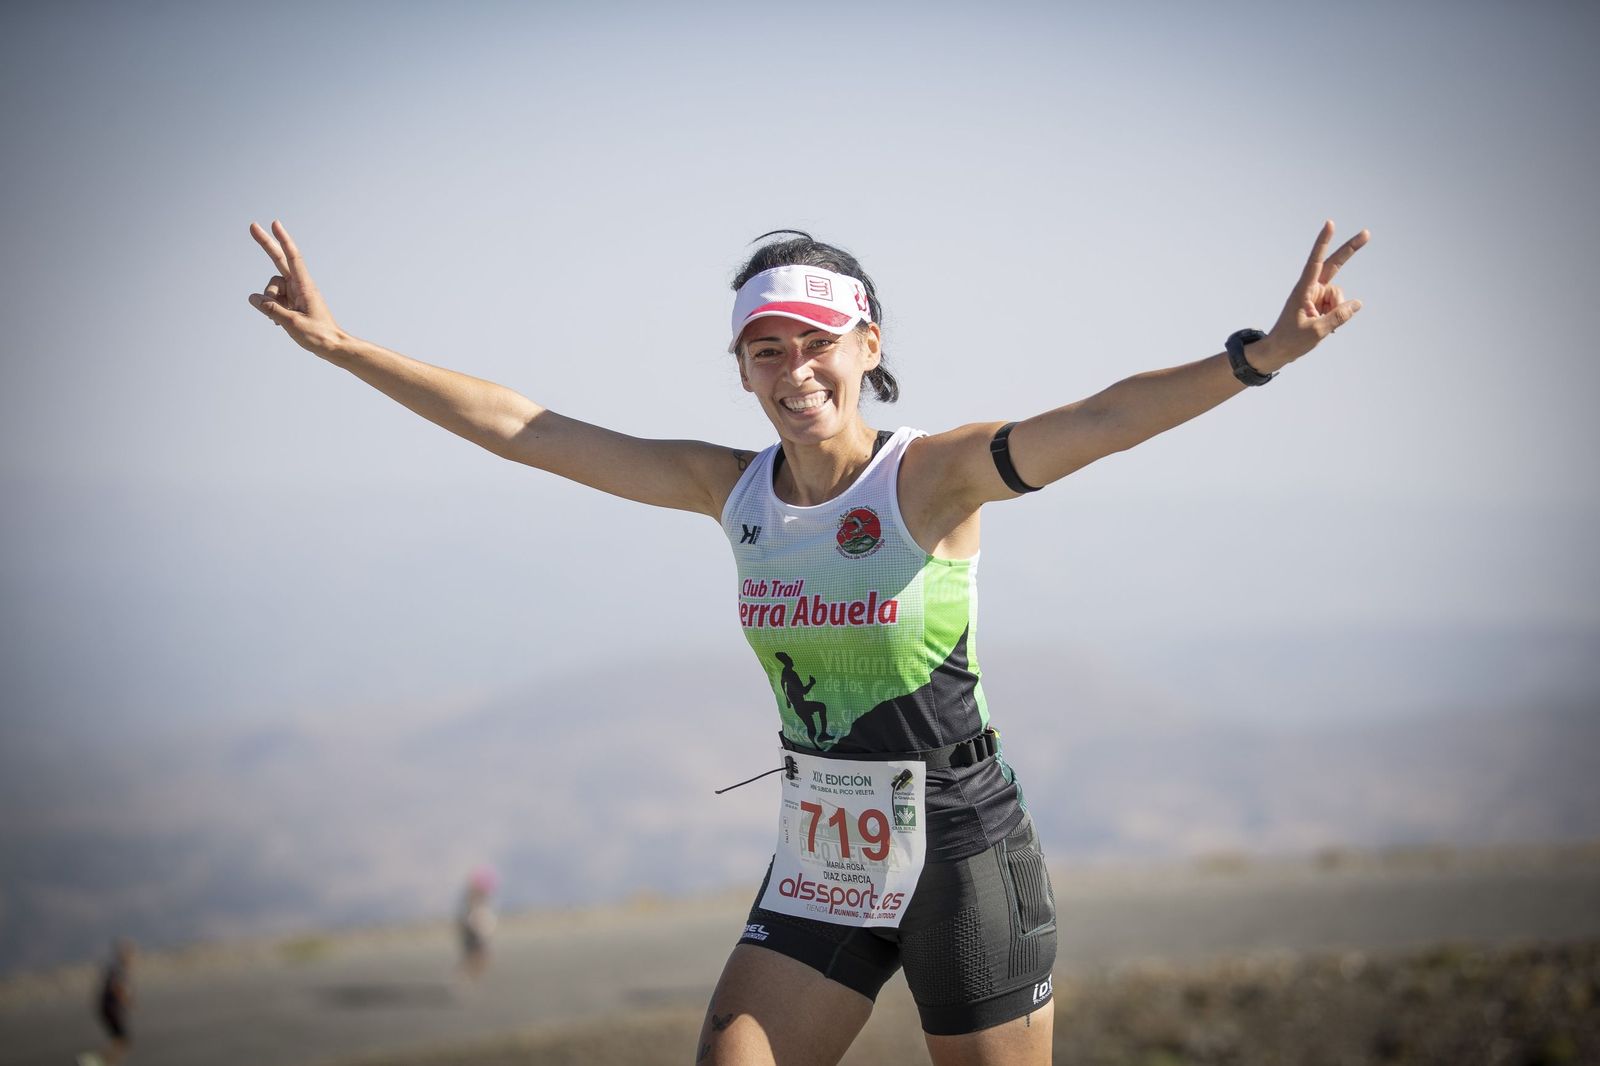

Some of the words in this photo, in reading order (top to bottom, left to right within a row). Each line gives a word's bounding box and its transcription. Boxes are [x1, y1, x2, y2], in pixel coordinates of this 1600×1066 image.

[743, 579, 767, 597] Club
[771, 580, 804, 597] Trail
[739, 602, 785, 627] erra
[791, 592, 898, 626] Abuela
[813, 771, 823, 783] XIX
[825, 773, 872, 786] EDICIÓN
[801, 800, 890, 861] 719
[826, 860, 845, 870] MARIA
[847, 863, 866, 871] ROSA
[823, 871, 840, 882] DIAZ
[841, 874, 872, 884] GARCIA
[806, 904, 828, 914] TIENDA
[834, 909, 859, 918] RUNNING
